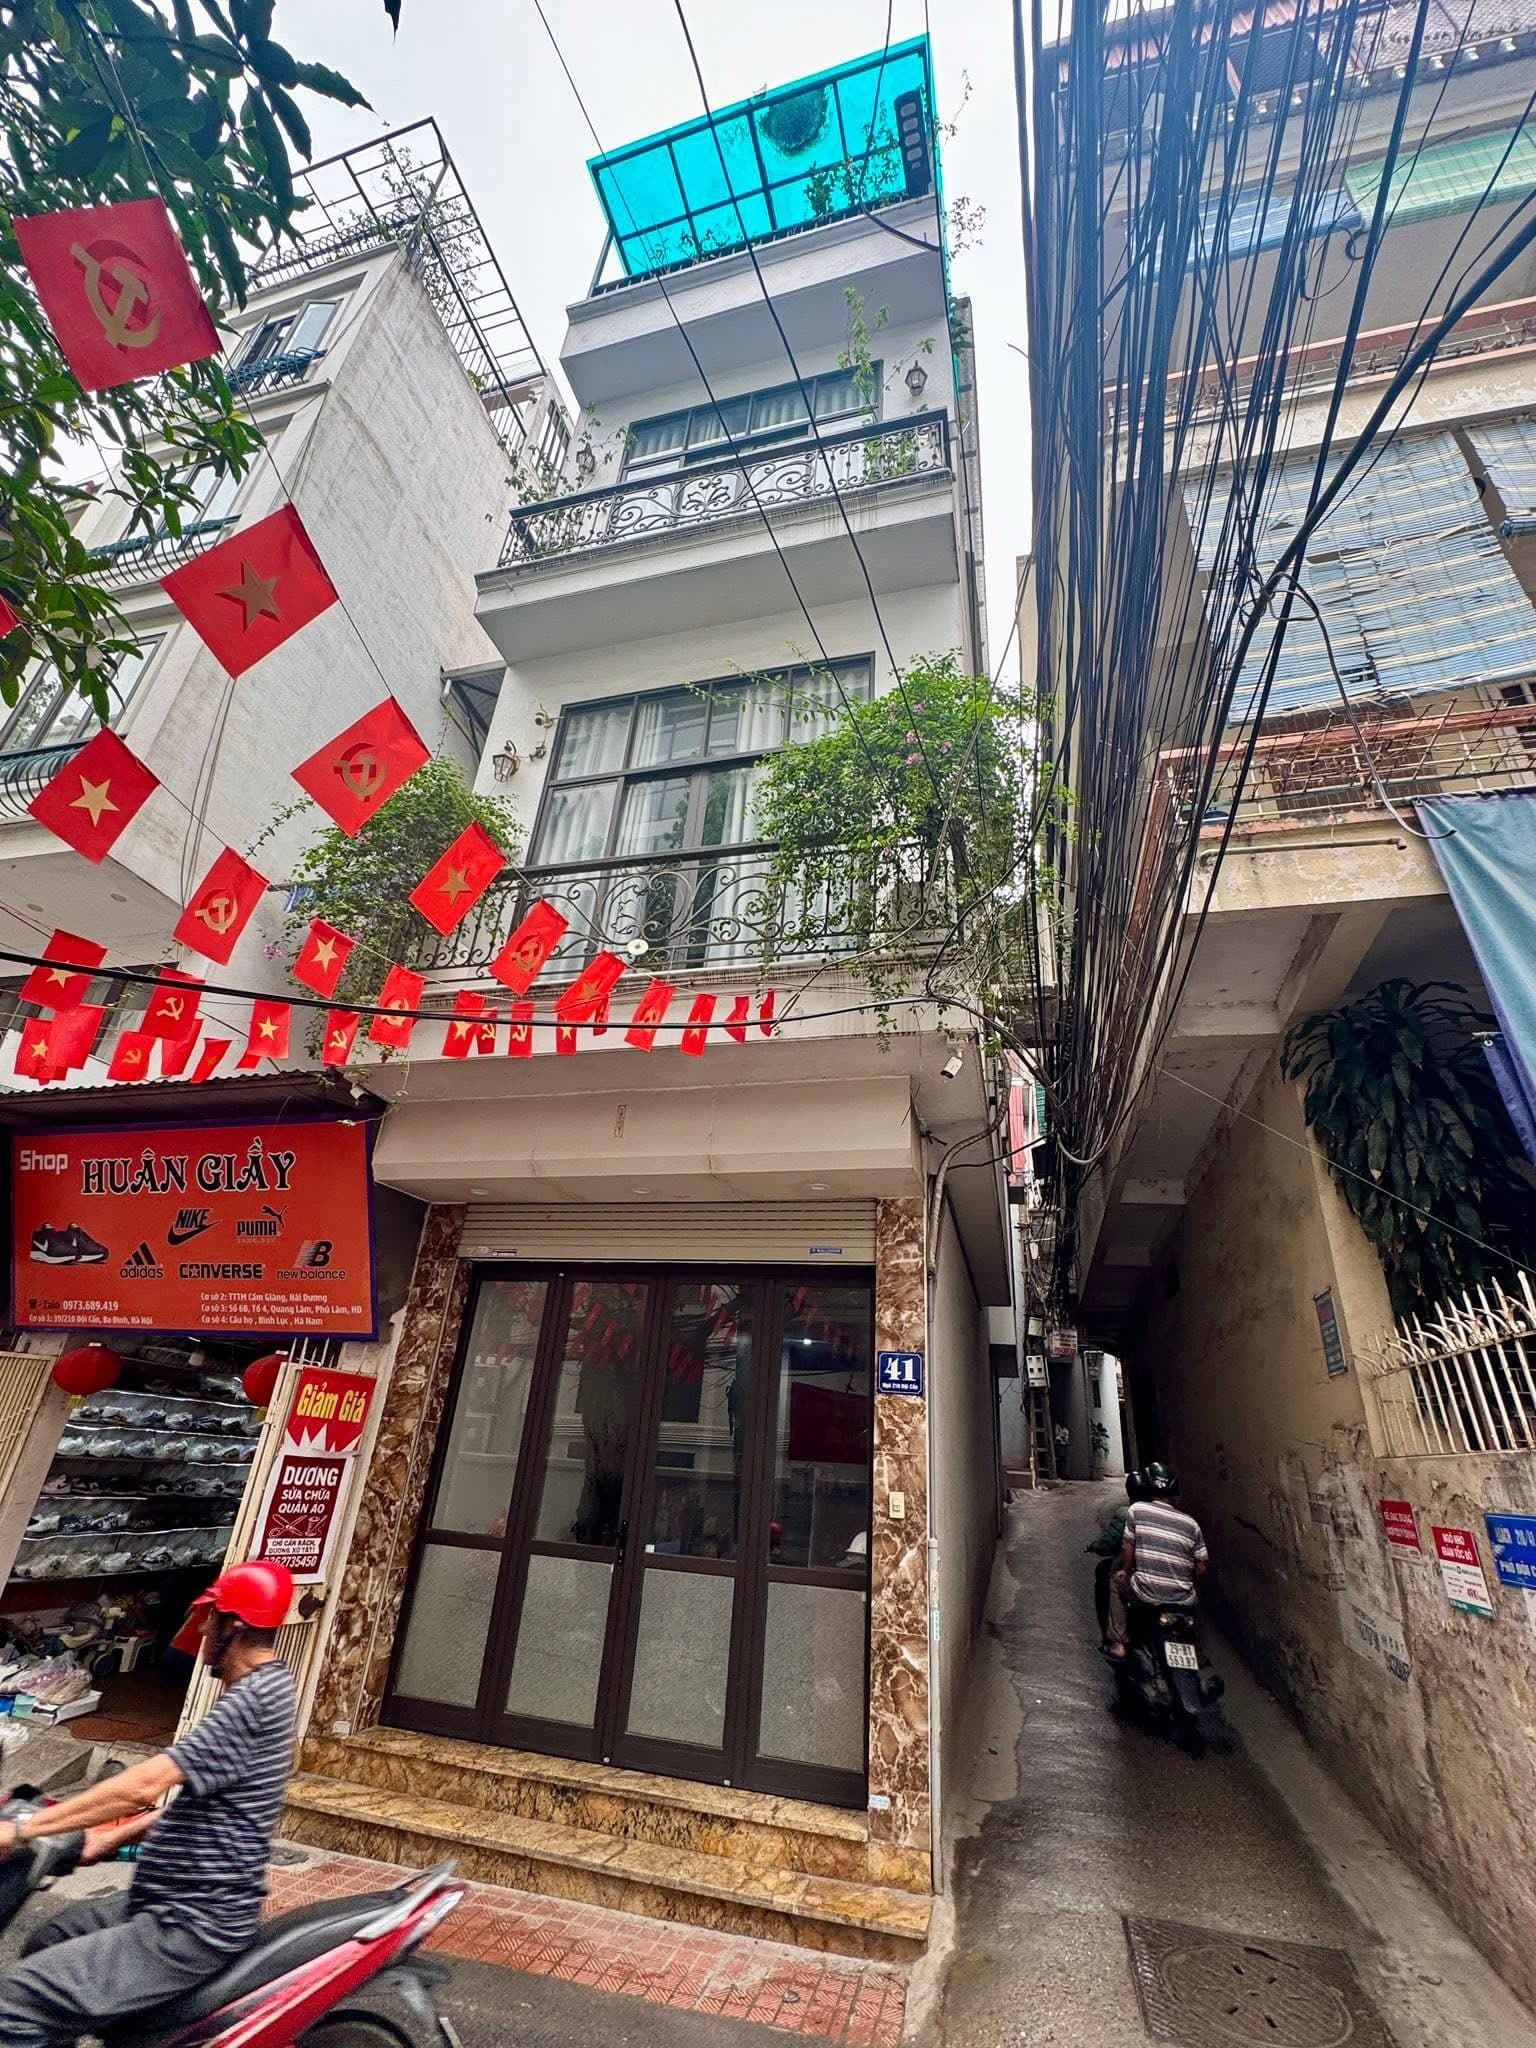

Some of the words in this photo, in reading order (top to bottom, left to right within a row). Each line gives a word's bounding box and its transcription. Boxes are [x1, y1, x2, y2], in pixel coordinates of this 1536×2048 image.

[20, 1150, 68, 1175] Shop
[80, 1147, 188, 1194] HUÂN
[174, 1208, 211, 1229] NIKE
[236, 1220, 277, 1236] PUMA
[120, 1265, 164, 1279] adidas
[179, 1263, 263, 1279] CONVERSE
[276, 1271, 298, 1280] new
[300, 1270, 346, 1281] balance
[63, 1300, 118, 1310] 0973.689.419
[884, 1357, 916, 1381] 41
[296, 1381, 339, 1419] Giảm
[338, 1389, 367, 1423] Giá
[281, 1465, 339, 1487] DƯƠNG
[281, 1486, 302, 1500] SỬA
[304, 1487, 331, 1501] CHỮA
[310, 1501, 325, 1514] ÁO
